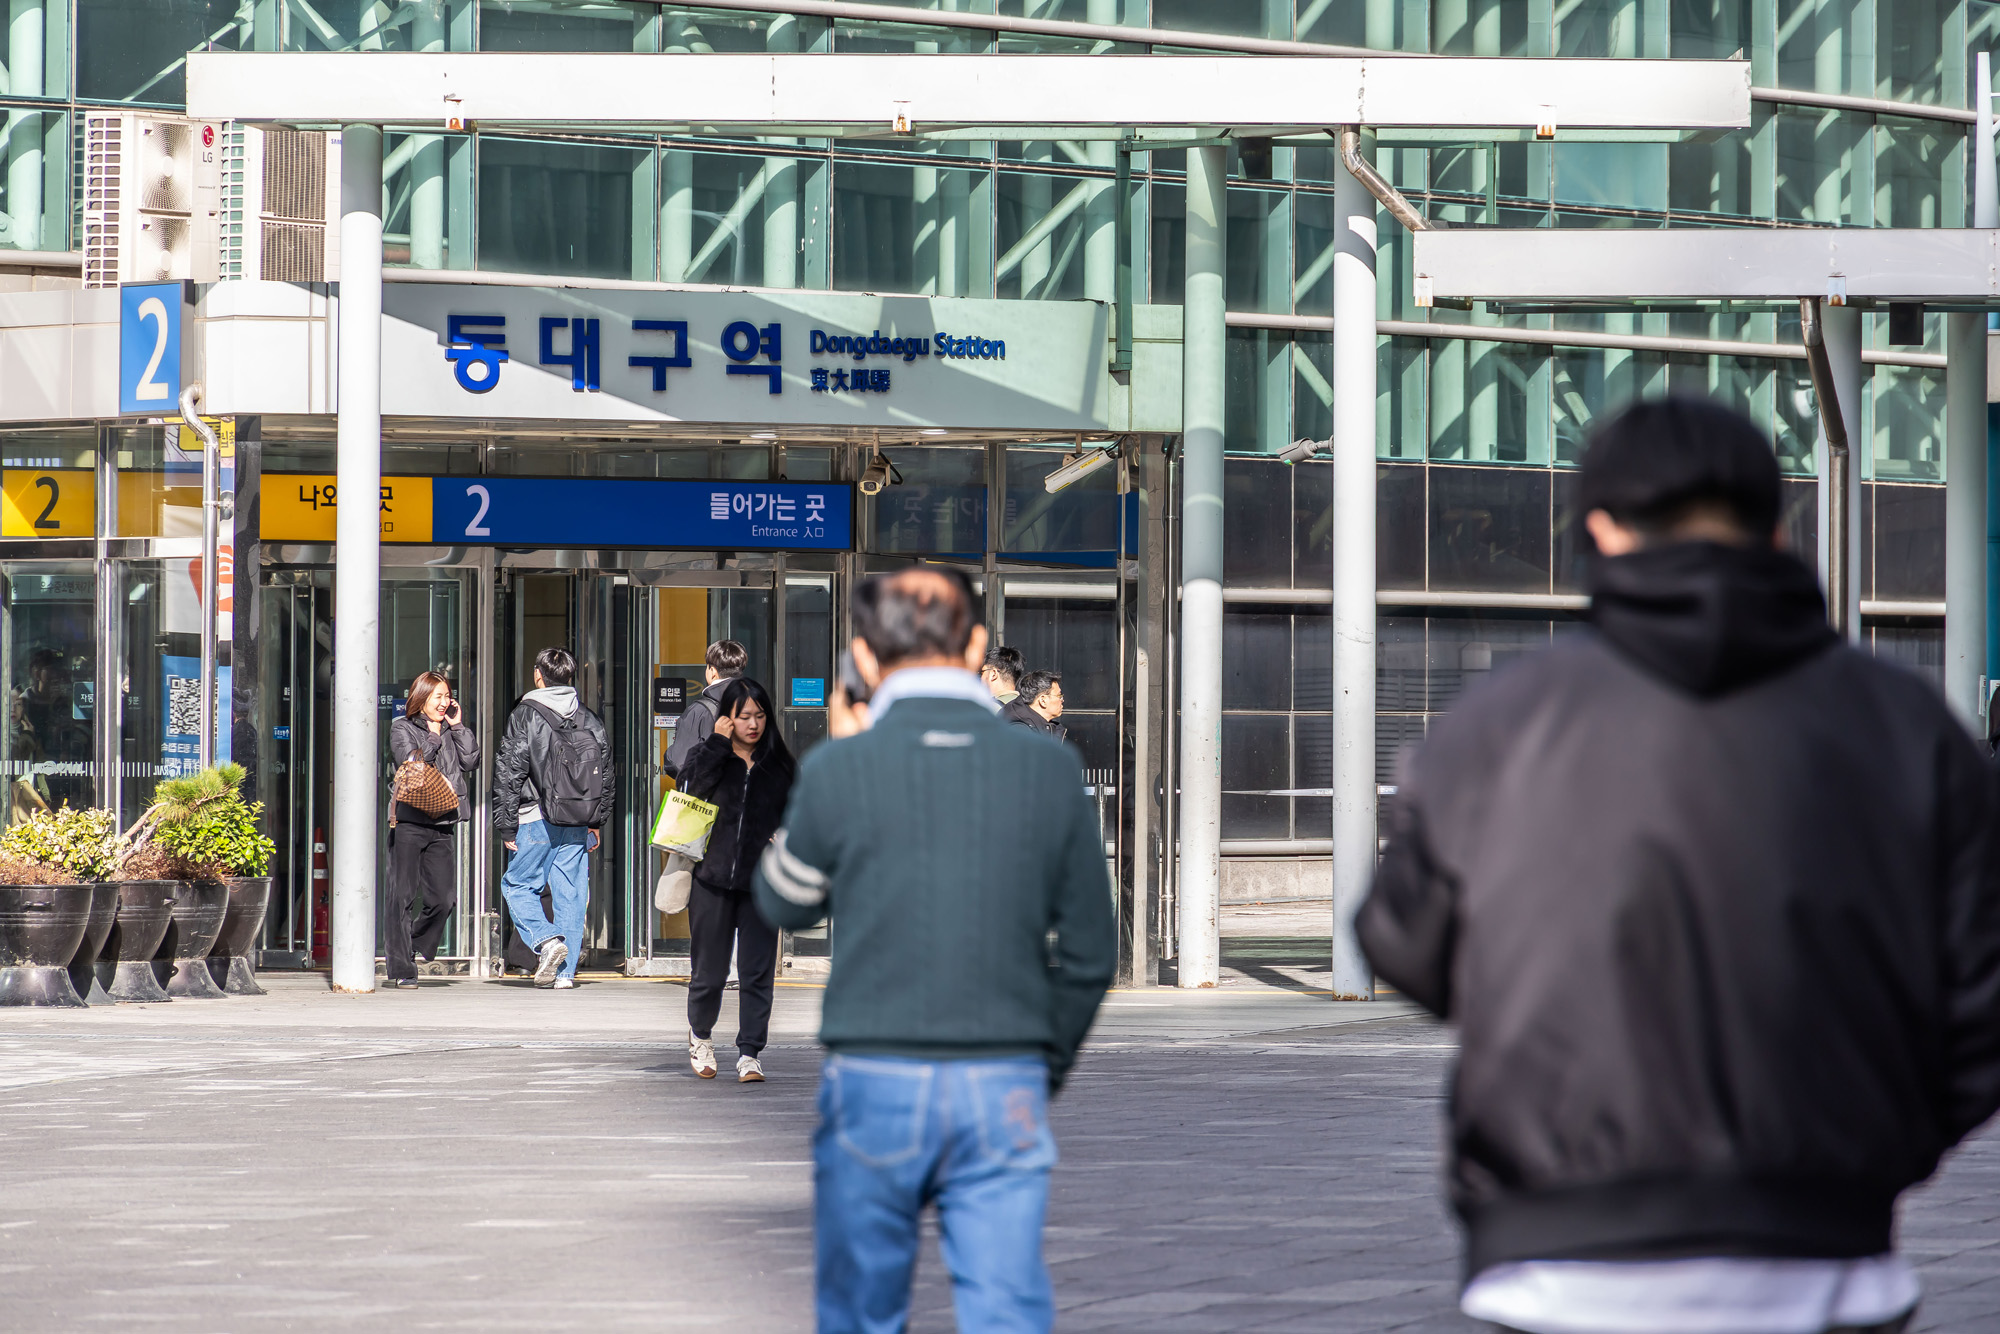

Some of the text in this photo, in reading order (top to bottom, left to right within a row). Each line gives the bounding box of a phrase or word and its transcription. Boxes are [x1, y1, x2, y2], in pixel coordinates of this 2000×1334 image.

[202, 151, 213, 163] LG
[136, 297, 168, 401] 2
[445, 315, 782, 395] 동대구역
[810, 329, 1006, 361] Dongdaegu Station
[810, 368, 891, 393] 東大邱驛
[34, 476, 60, 529] 2
[465, 484, 491, 537] 2
[710, 492, 825, 522] 들어가는 곳
[752, 525, 798, 537] Entrance
[803, 526, 824, 538] 入口
[660, 687, 681, 697] 출입문
[672, 796, 713, 816] OLIVE BETTER
